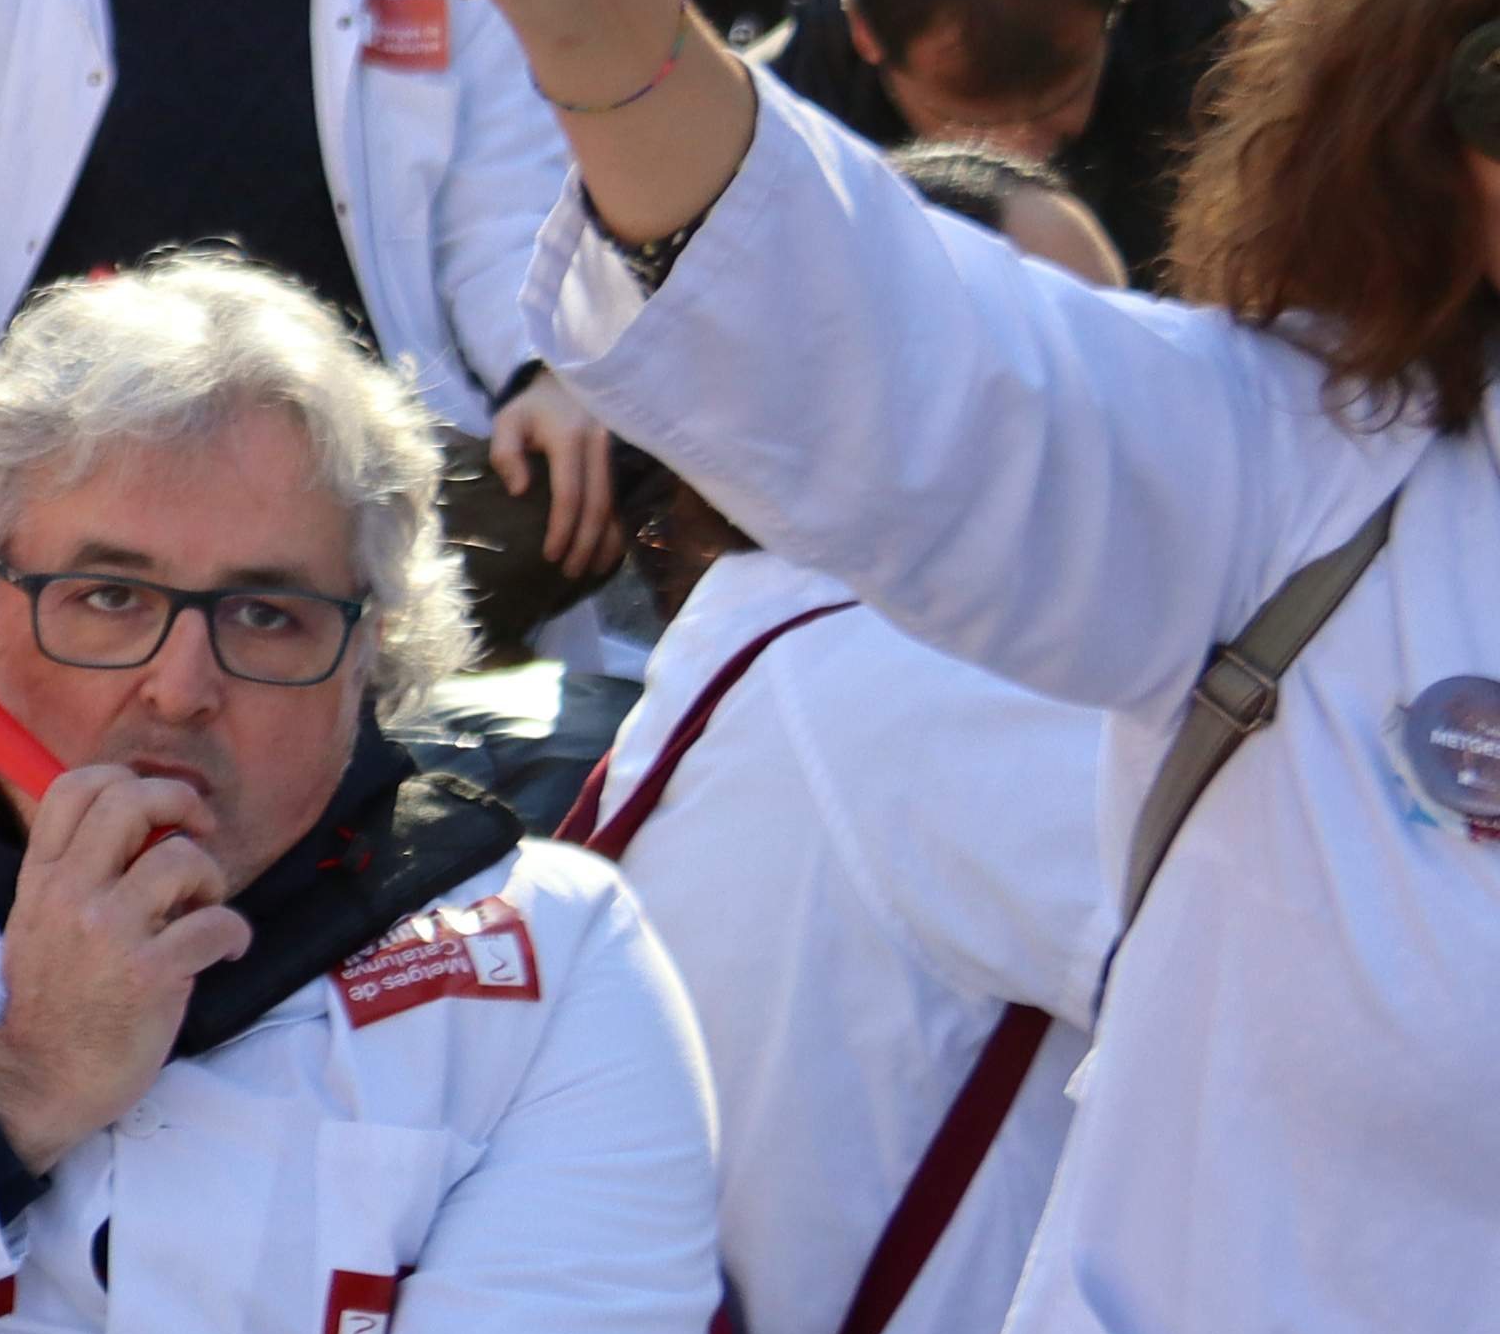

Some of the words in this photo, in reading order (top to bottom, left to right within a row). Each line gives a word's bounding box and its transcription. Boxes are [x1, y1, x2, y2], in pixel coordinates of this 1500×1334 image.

[340, 938, 461, 980] Catalunya
[380, 956, 471, 992] Metges
[347, 981, 381, 1002] de
